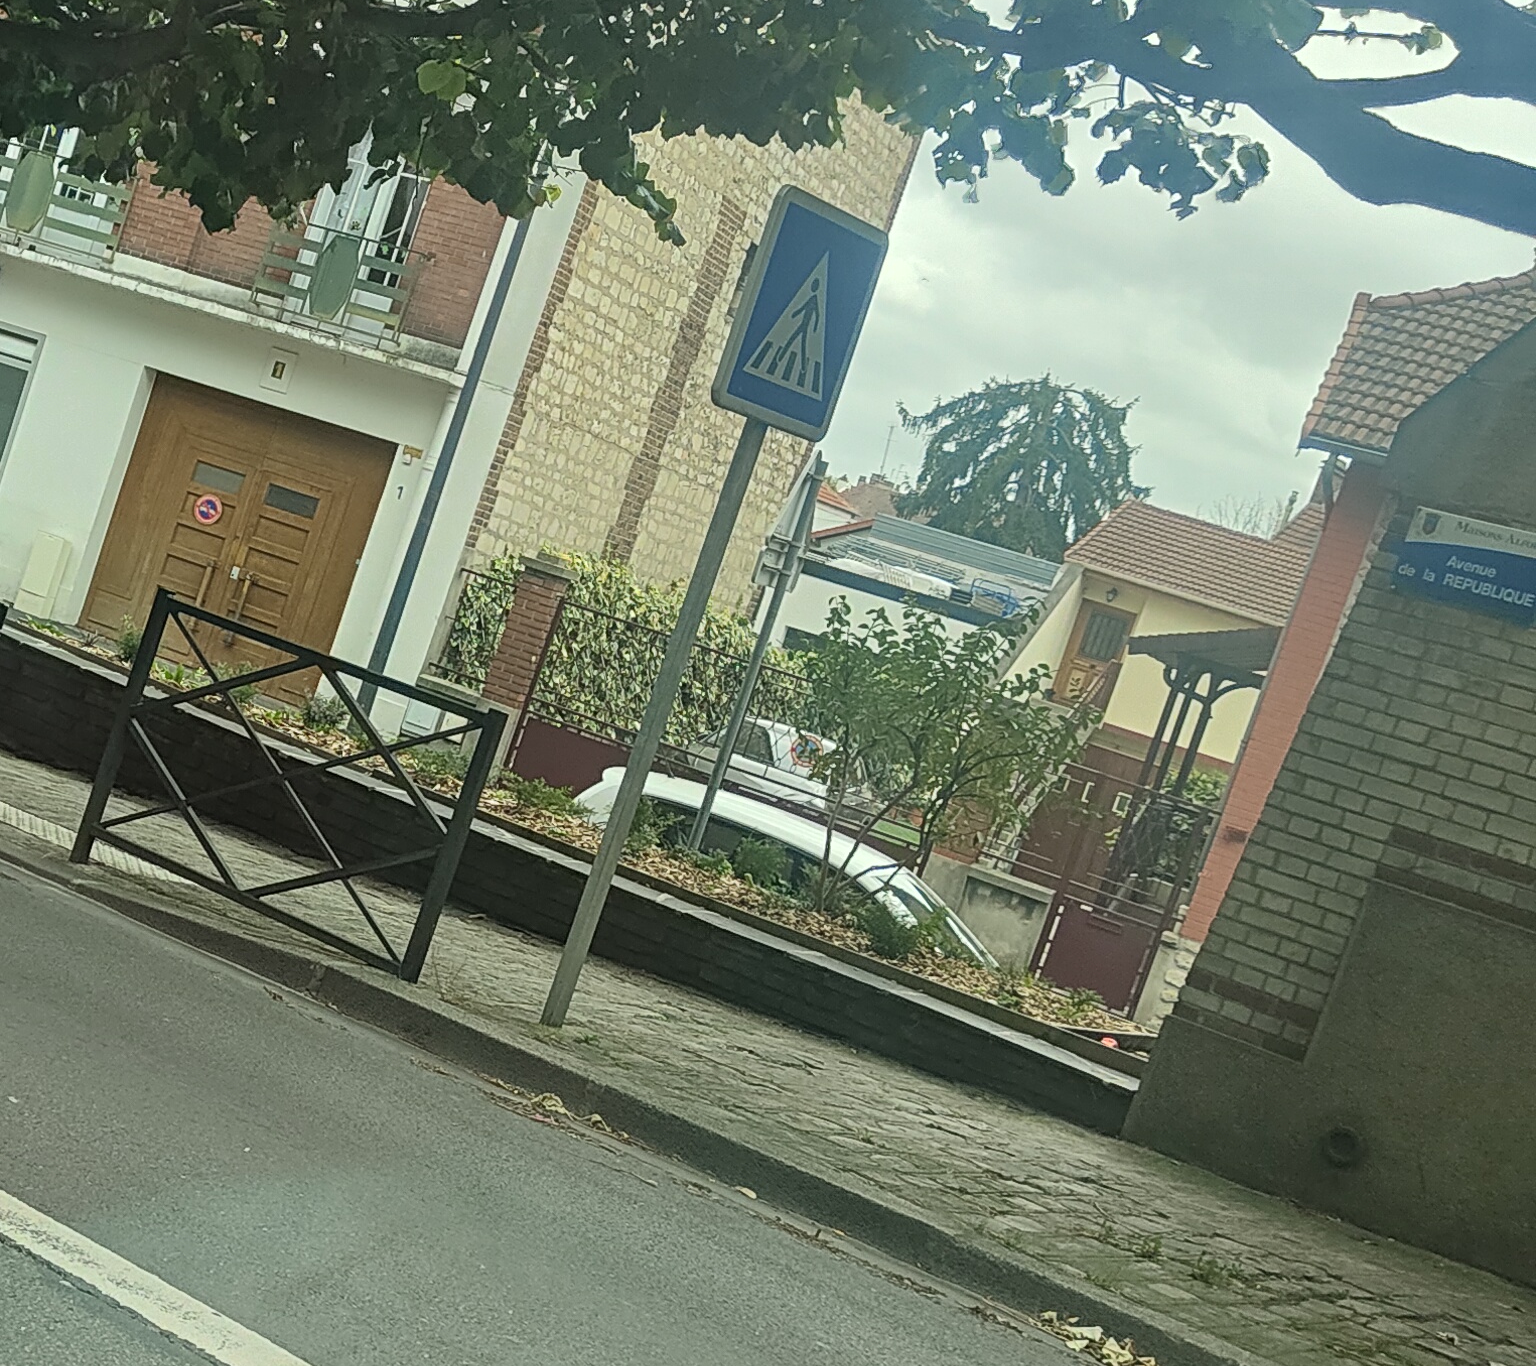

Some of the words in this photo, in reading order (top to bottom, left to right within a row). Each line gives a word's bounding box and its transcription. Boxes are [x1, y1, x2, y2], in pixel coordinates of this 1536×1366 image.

[1445, 555, 1497, 578] Avenue
[1397, 563, 1416, 577] de
[1422, 568, 1435, 582] la
[1442, 573, 1536, 608] REPUBLIQUE
